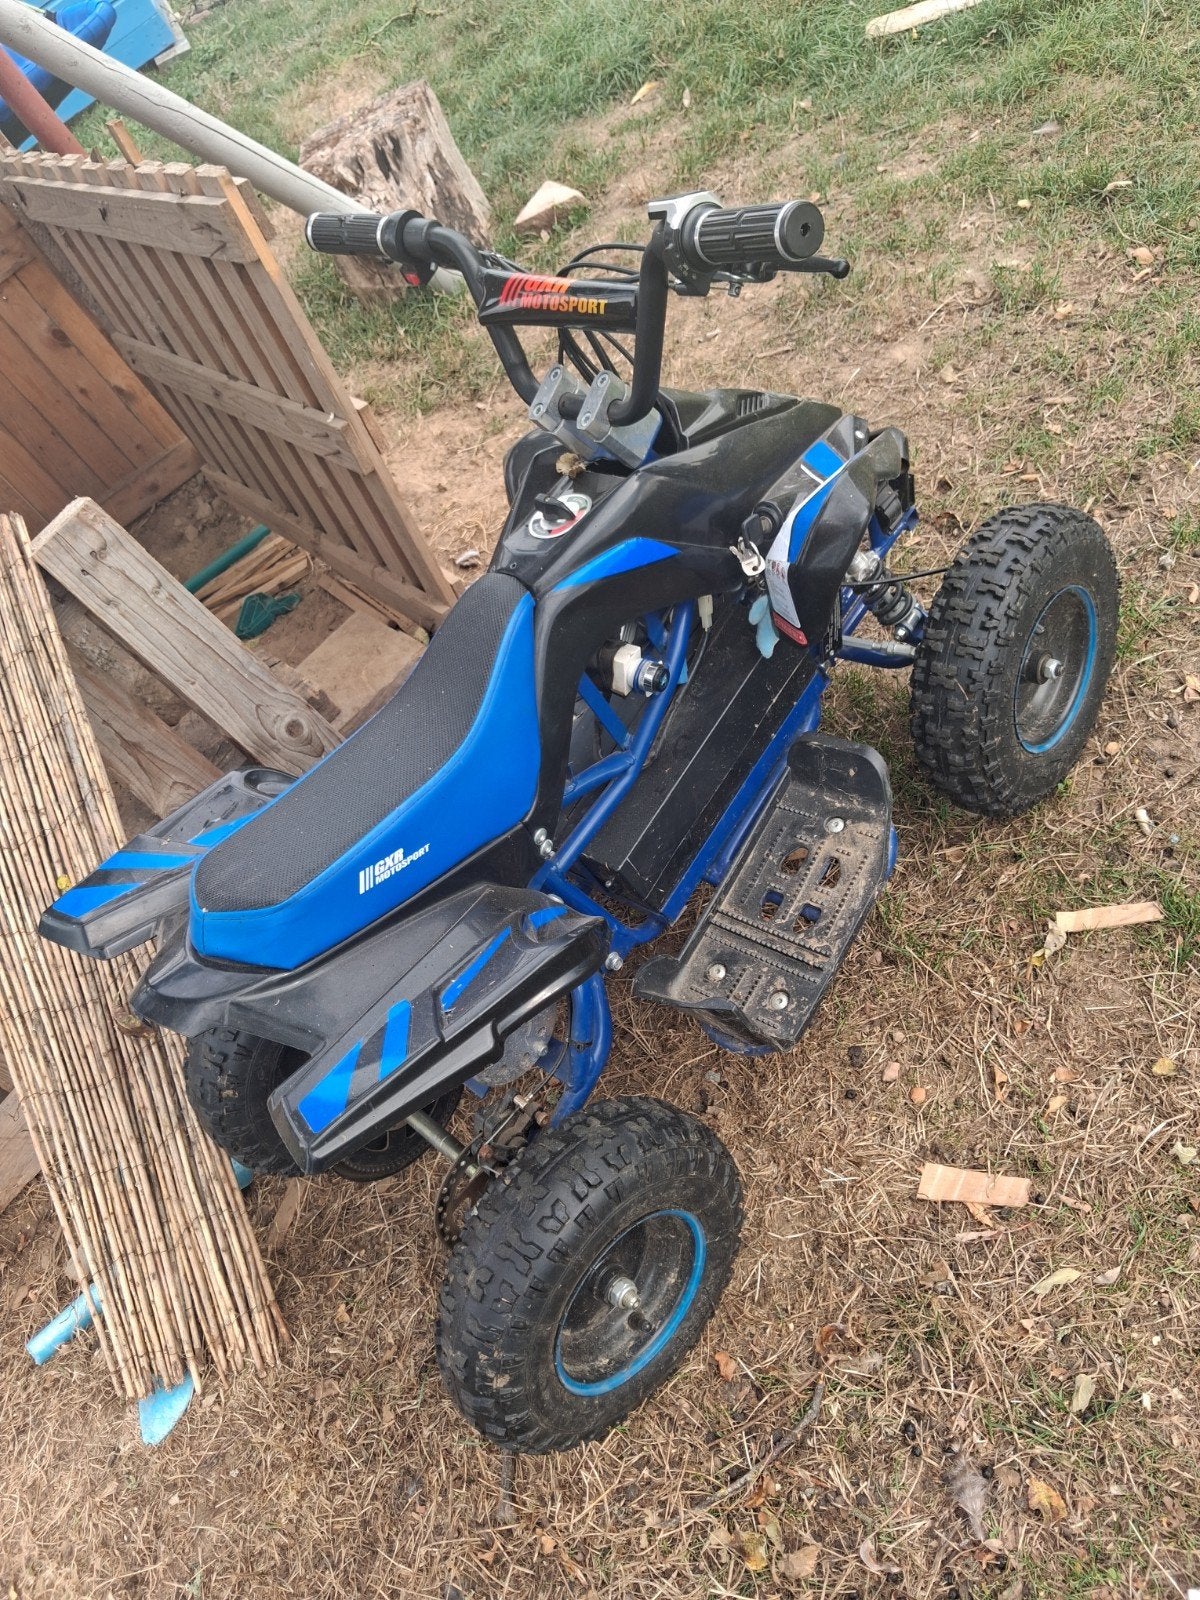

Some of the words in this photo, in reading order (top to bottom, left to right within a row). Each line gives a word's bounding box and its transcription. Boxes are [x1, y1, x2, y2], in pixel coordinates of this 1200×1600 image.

[520, 292, 608, 315] MOTOSPORT
[374, 848, 404, 876] GXR
[375, 843, 430, 885] MOTOSPORT
